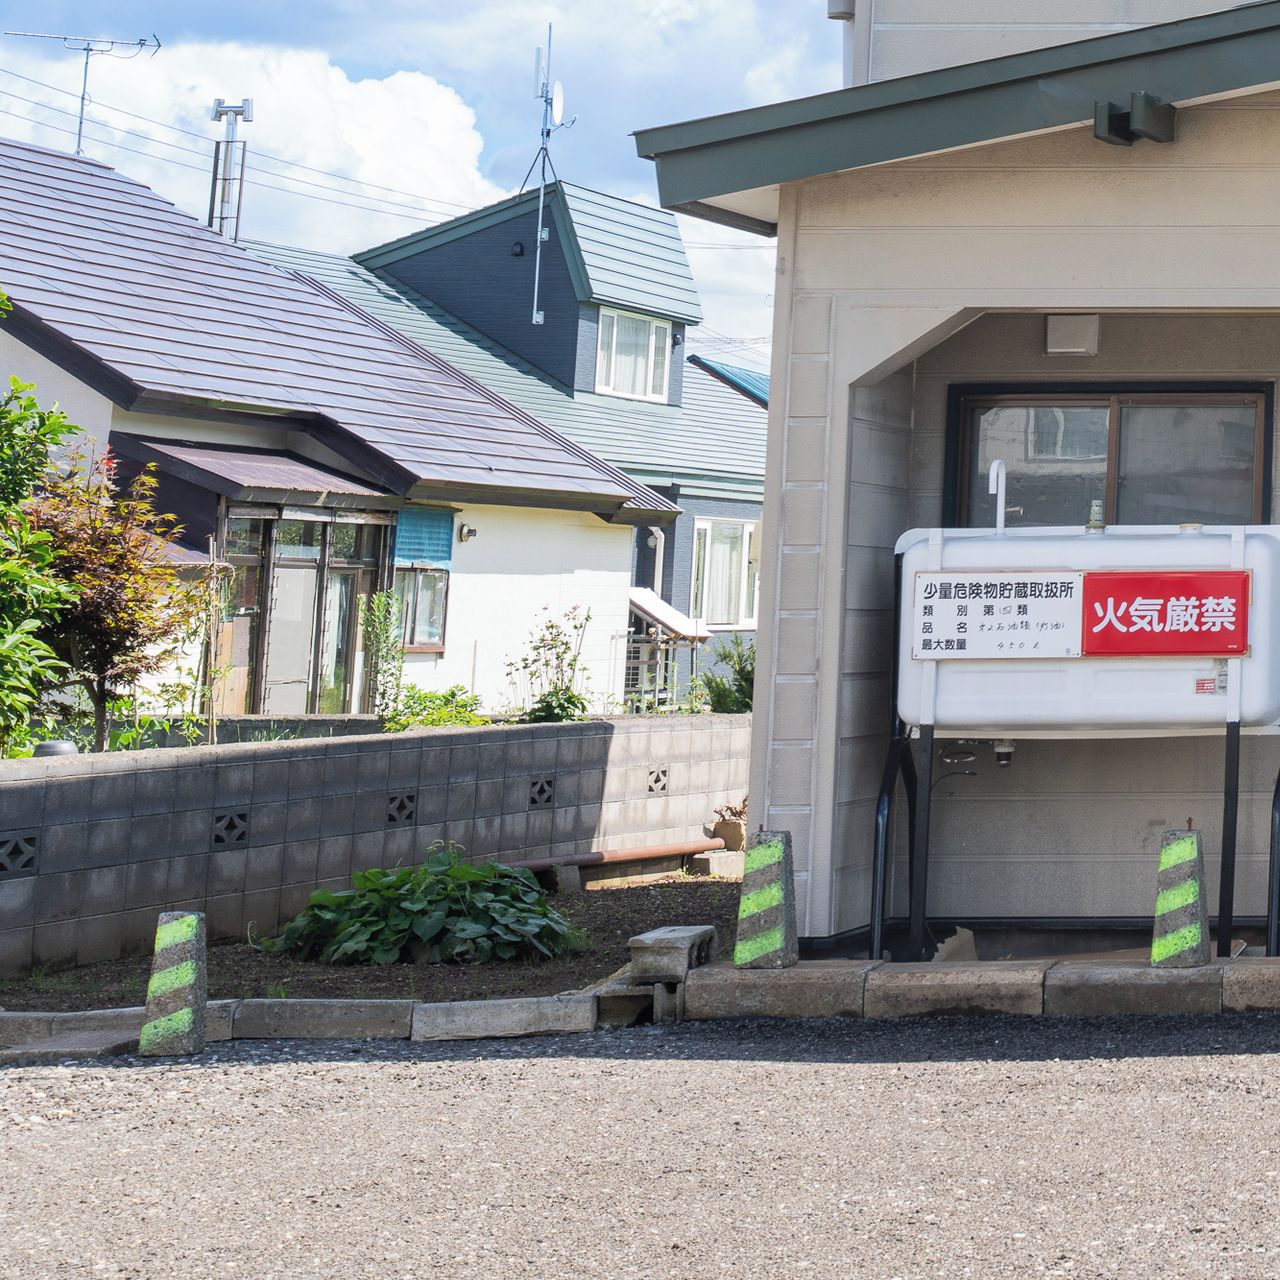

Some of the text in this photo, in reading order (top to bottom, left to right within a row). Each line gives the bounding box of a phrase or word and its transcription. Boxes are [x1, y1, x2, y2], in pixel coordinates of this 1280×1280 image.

[923, 581, 1074, 600] 少量危険物貯蔵取扱所
[1092, 596, 1236, 633] 火気厳禁
[921, 638, 967, 651] 最大数量
